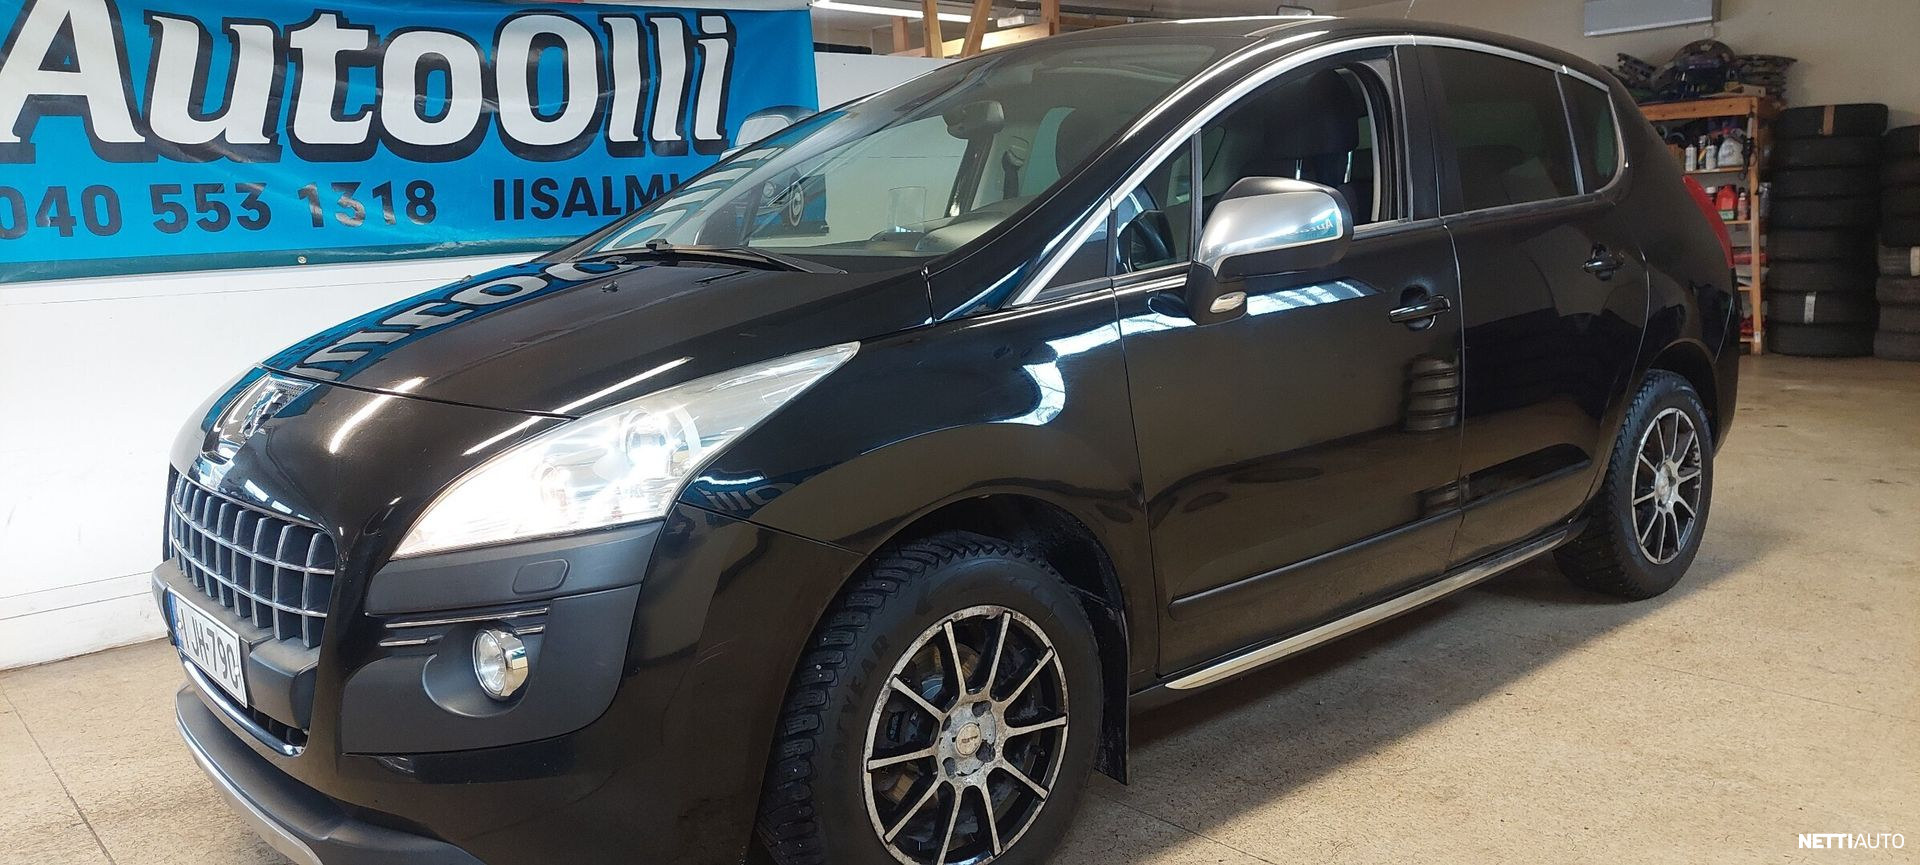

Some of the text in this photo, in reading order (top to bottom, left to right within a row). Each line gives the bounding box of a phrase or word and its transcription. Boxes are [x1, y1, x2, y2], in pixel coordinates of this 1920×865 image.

[0, 0, 735, 161] AutoOlli
[0, 185, 123, 240] 040
[150, 183, 272, 234] 553
[298, 179, 437, 228] 1318
